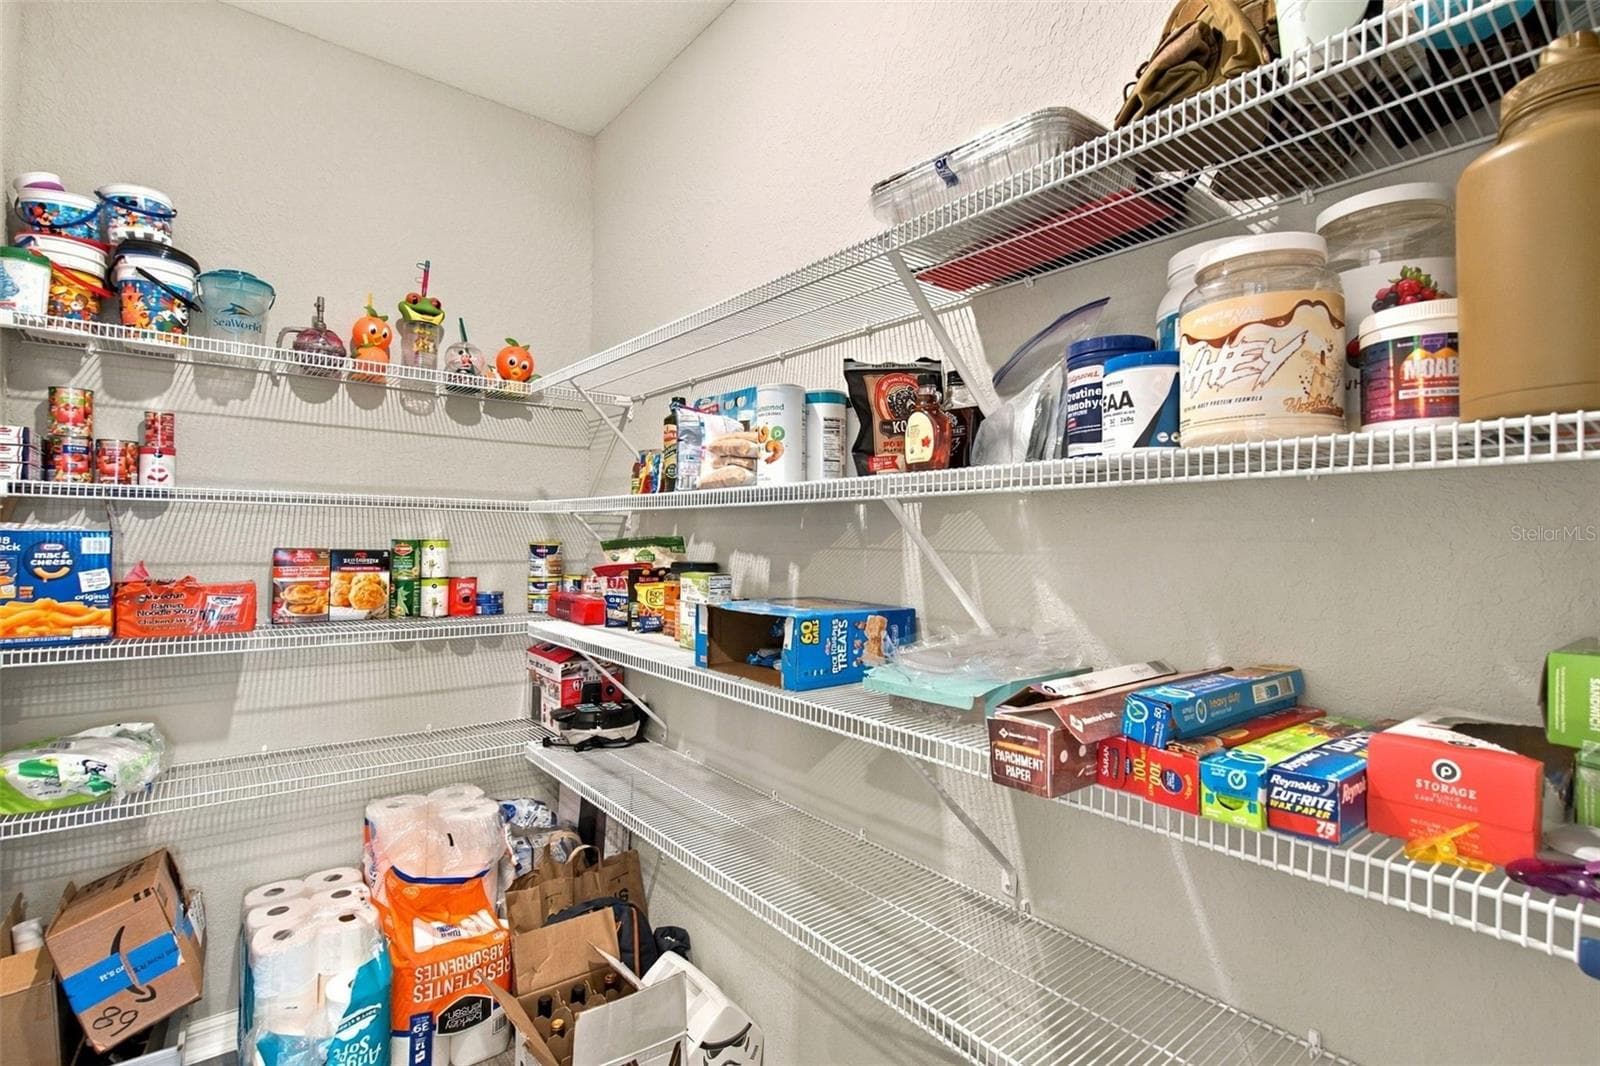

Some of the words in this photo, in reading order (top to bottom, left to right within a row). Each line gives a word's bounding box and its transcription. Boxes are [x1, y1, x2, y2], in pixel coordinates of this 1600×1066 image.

[212, 319, 263, 334] SeaWorld
[75, 593, 110, 602] original
[800, 621, 813, 644] 60
[838, 619, 849, 671] TREATS
[994, 748, 1044, 772] PARCHMENT
[1101, 745, 1109, 777] SARAN
[1134, 758, 1146, 782] 100
[1005, 764, 1032, 782] PAPER
[1149, 762, 1162, 787] 100
[1270, 774, 1321, 793] Reynolds
[1270, 786, 1336, 811] CUT-RITE
[1415, 778, 1477, 800] STORAGE
[1269, 799, 1292, 811] WAX
[1295, 804, 1331, 820] PAPER
[1316, 820, 1337, 836] 75
[415, 944, 505, 981] ABSORBENTES
[413, 1021, 430, 1033] 39
[333, 1035, 370, 1062] Soft
[338, 1043, 382, 1066] Ang
